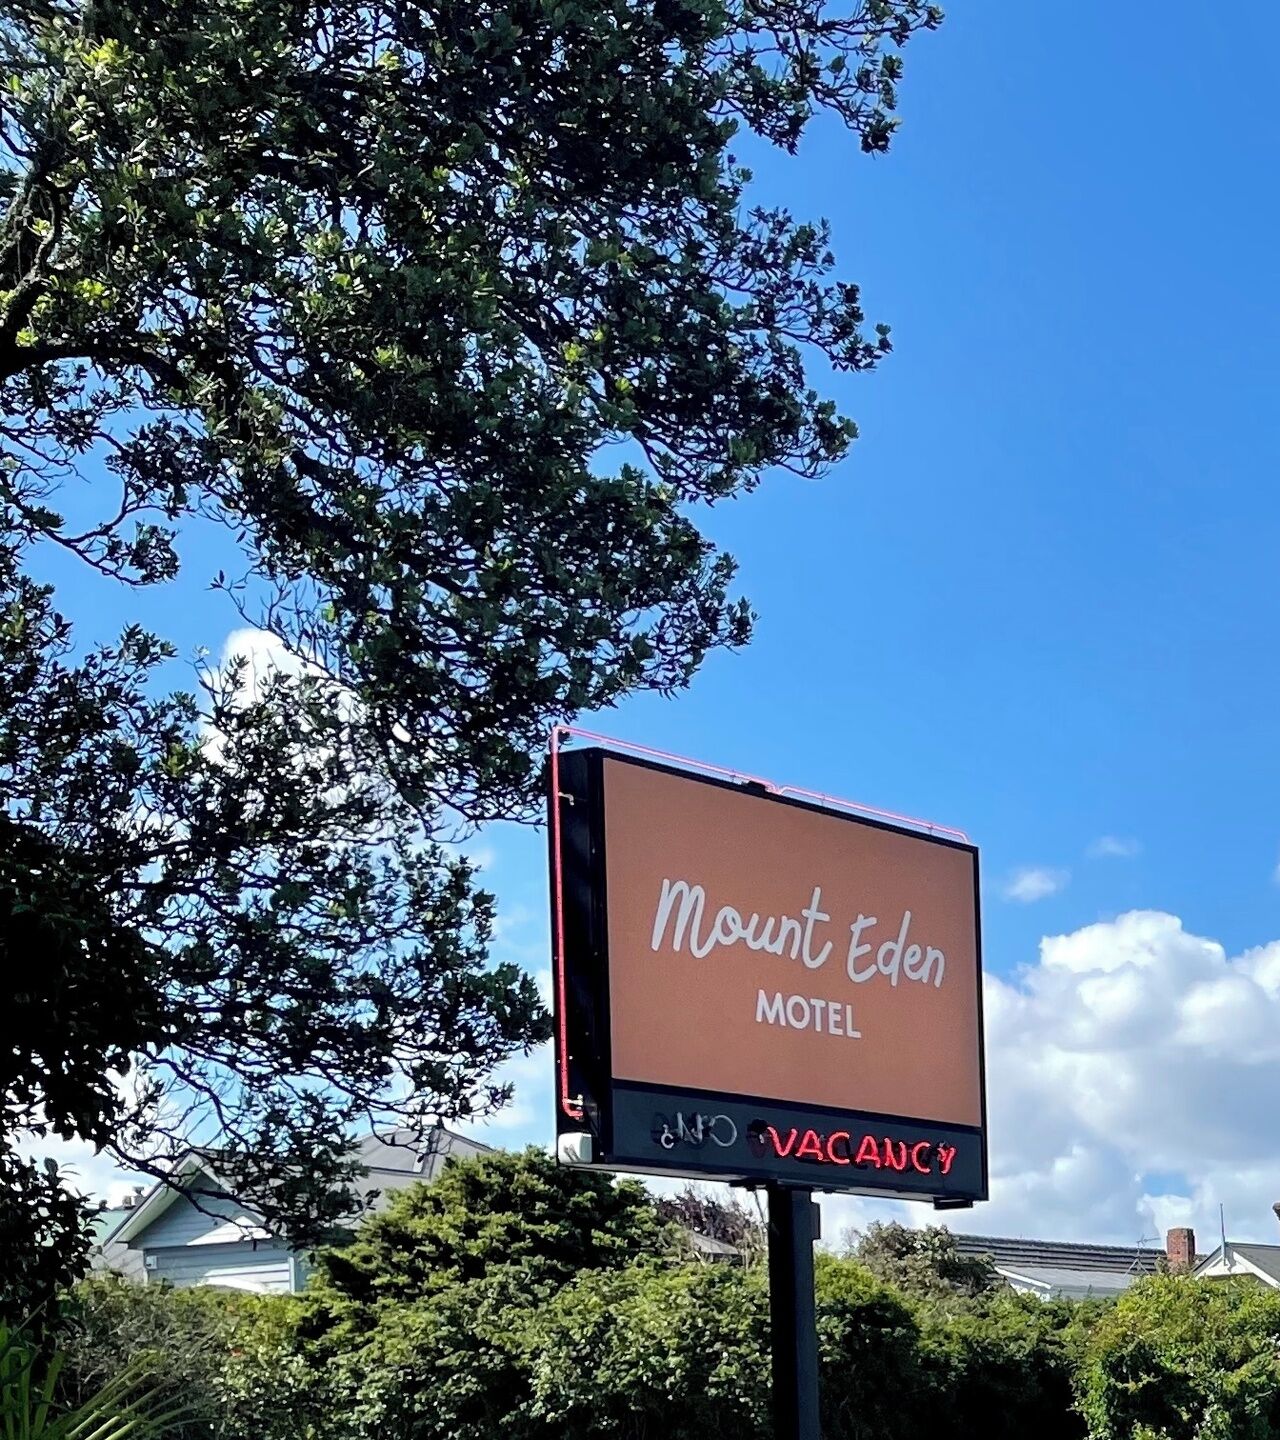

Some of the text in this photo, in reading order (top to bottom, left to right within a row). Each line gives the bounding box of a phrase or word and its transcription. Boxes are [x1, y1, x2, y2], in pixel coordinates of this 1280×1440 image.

[651, 878, 945, 988] Mount Eden
[755, 989, 862, 1038] MOTEL
[675, 1111, 957, 1175] NO VACANCY
